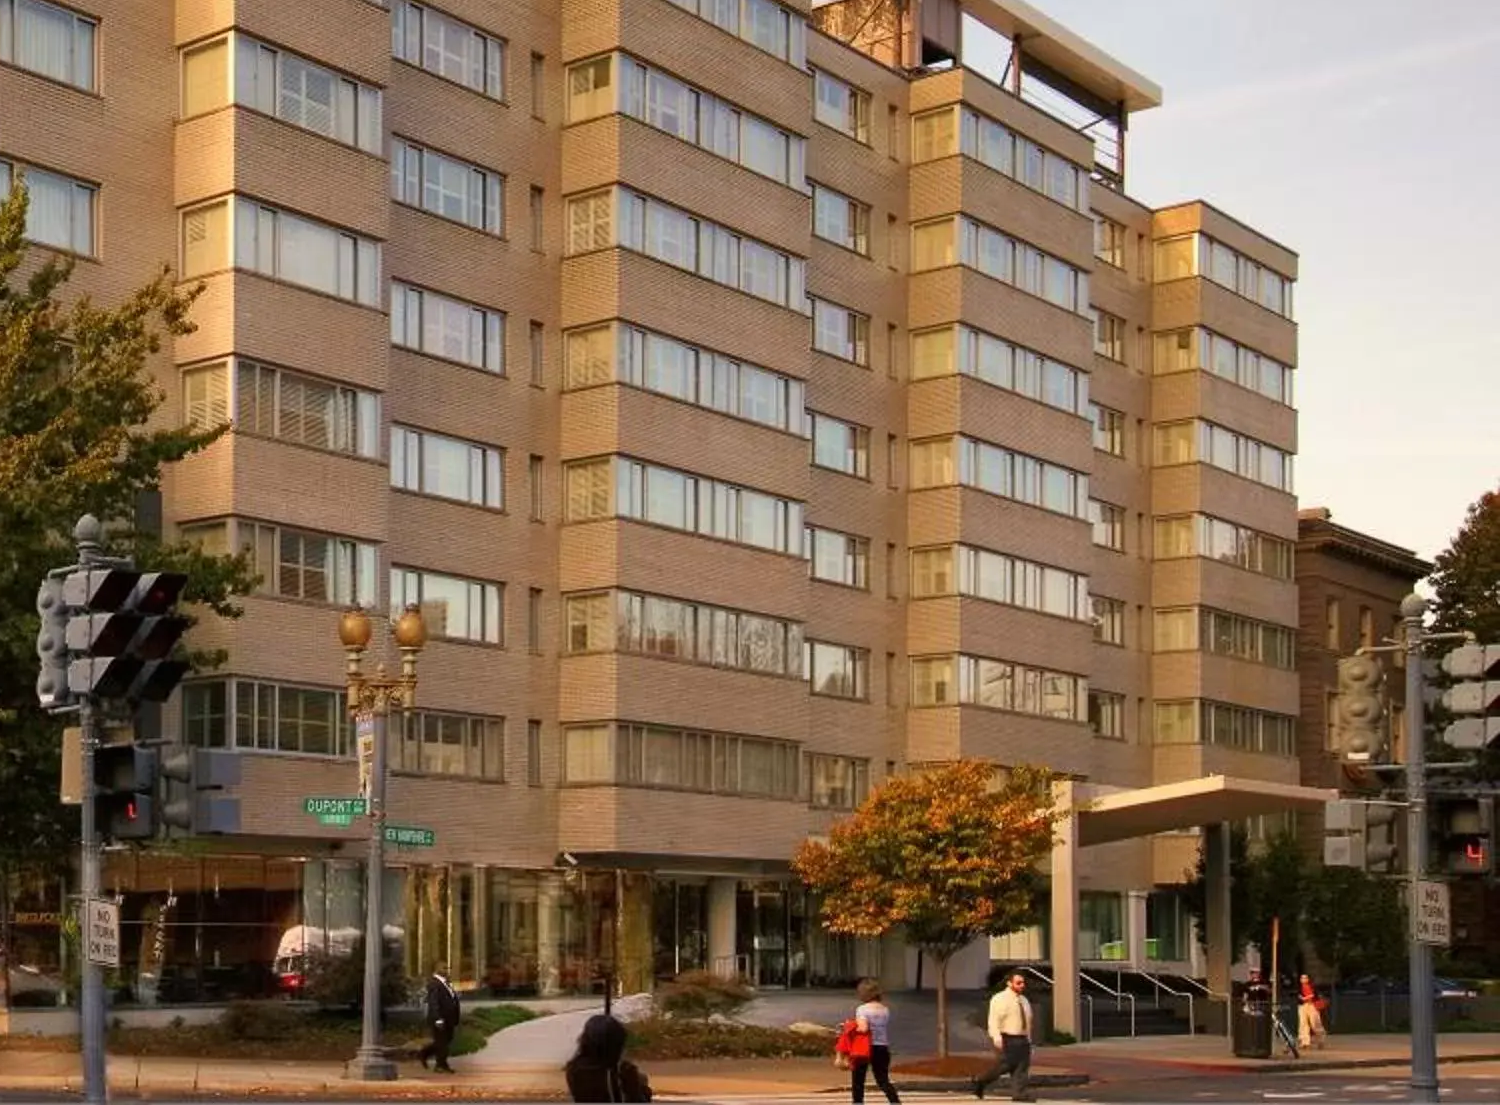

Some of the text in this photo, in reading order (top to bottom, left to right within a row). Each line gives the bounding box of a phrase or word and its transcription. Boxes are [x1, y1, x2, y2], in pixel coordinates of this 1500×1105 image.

[307, 799, 352, 812] DUPONT
[1425, 887, 1439, 903] NO
[97, 909, 111, 924] NO
[1420, 903, 1445, 918] TURN
[93, 924, 115, 939] TURN
[1416, 920, 1446, 937] ON RED
[90, 940, 117, 957] ON RED
